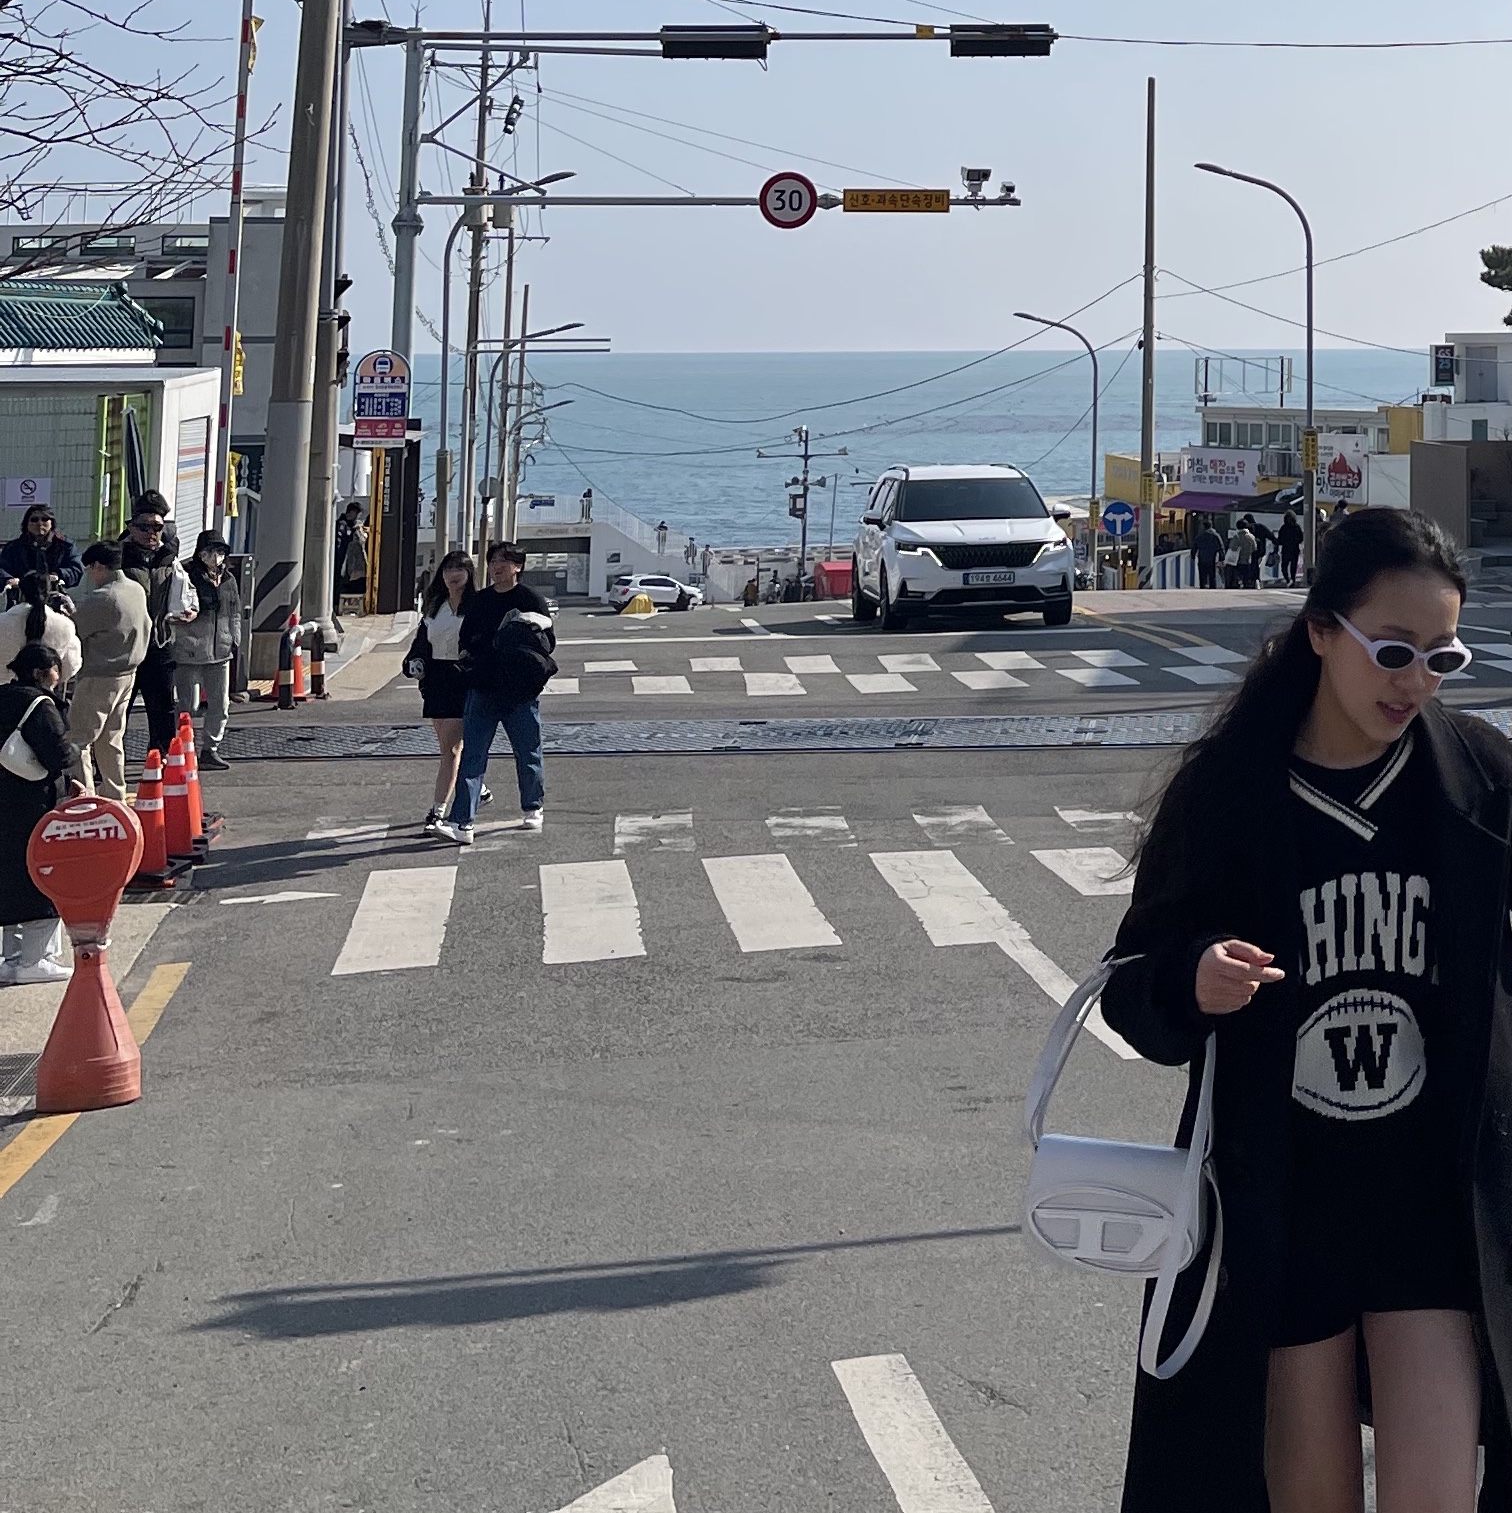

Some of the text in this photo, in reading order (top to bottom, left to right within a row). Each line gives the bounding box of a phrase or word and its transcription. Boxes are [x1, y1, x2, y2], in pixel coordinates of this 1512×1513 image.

[773, 189, 803, 212] 30
[1438, 348, 1451, 357] GS
[1439, 359, 1451, 369] 25
[1300, 870, 1438, 986] HING
[1324, 1023, 1398, 1092] W
